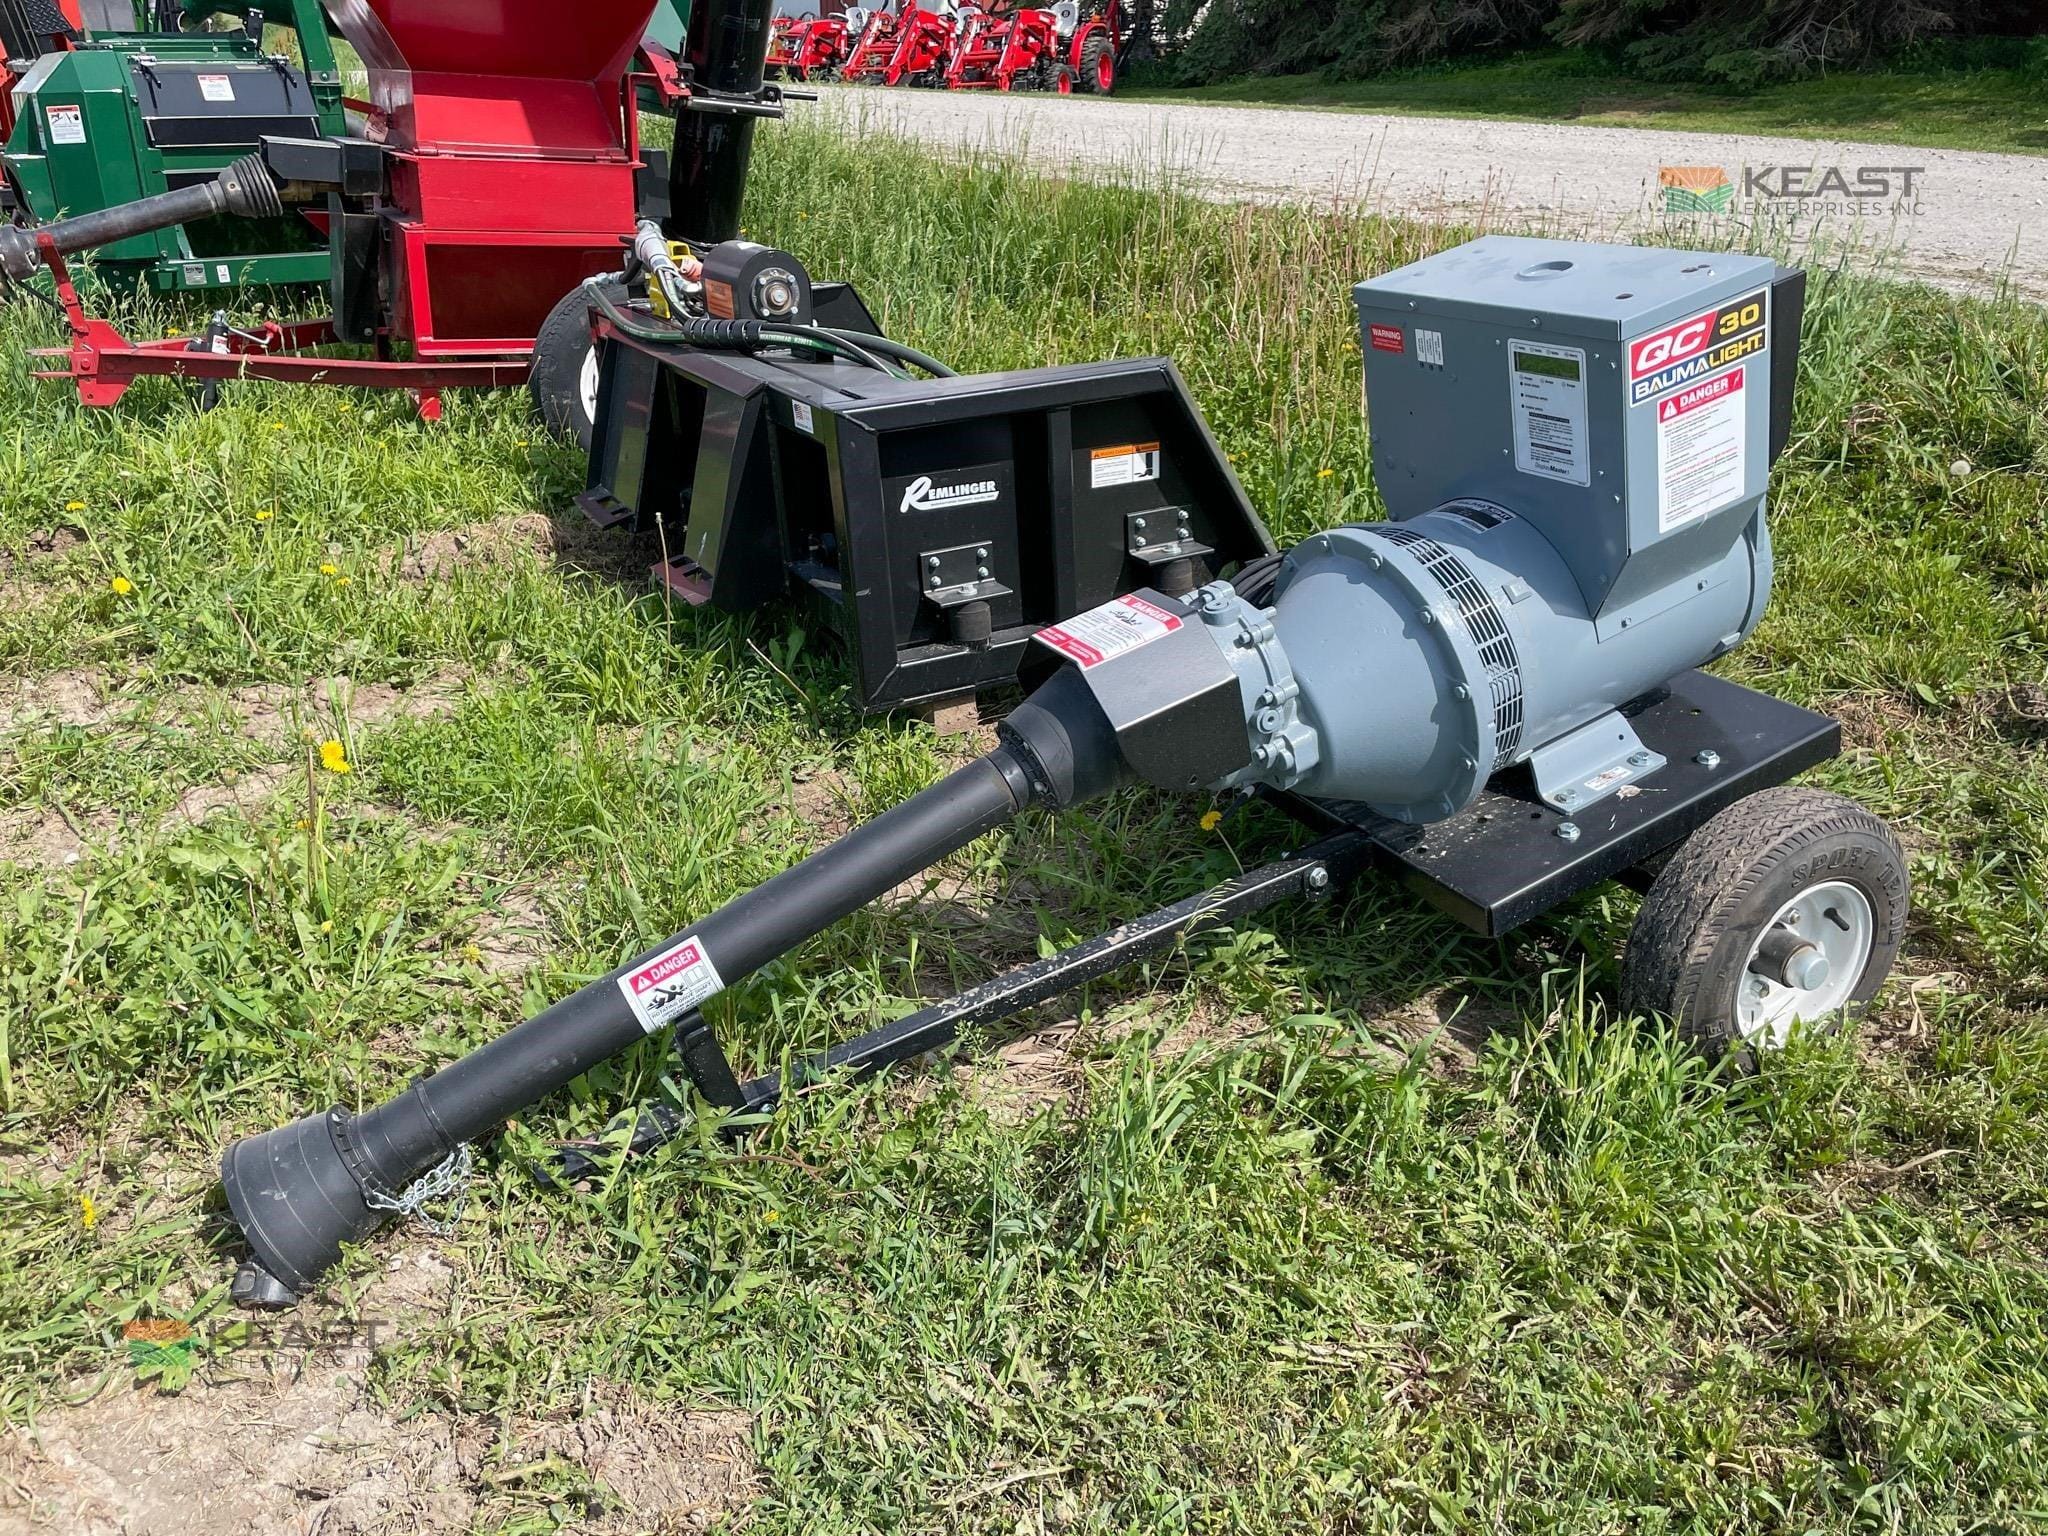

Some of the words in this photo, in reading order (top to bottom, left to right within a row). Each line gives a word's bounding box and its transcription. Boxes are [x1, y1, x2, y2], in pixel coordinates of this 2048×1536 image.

[1371, 328, 1401, 340] WARNING
[1636, 320, 1707, 372] QC
[1719, 303, 1760, 336] 30
[1635, 332, 1763, 400] BAUMALIGHT
[1679, 377, 1729, 408] DANGER
[900, 476, 999, 513] REMLINGER
[1131, 601, 1172, 622] DANGER
[1792, 847, 1879, 888] SPORT
[1877, 862, 1906, 945] TRAIL
[649, 948, 697, 981] DANGER
